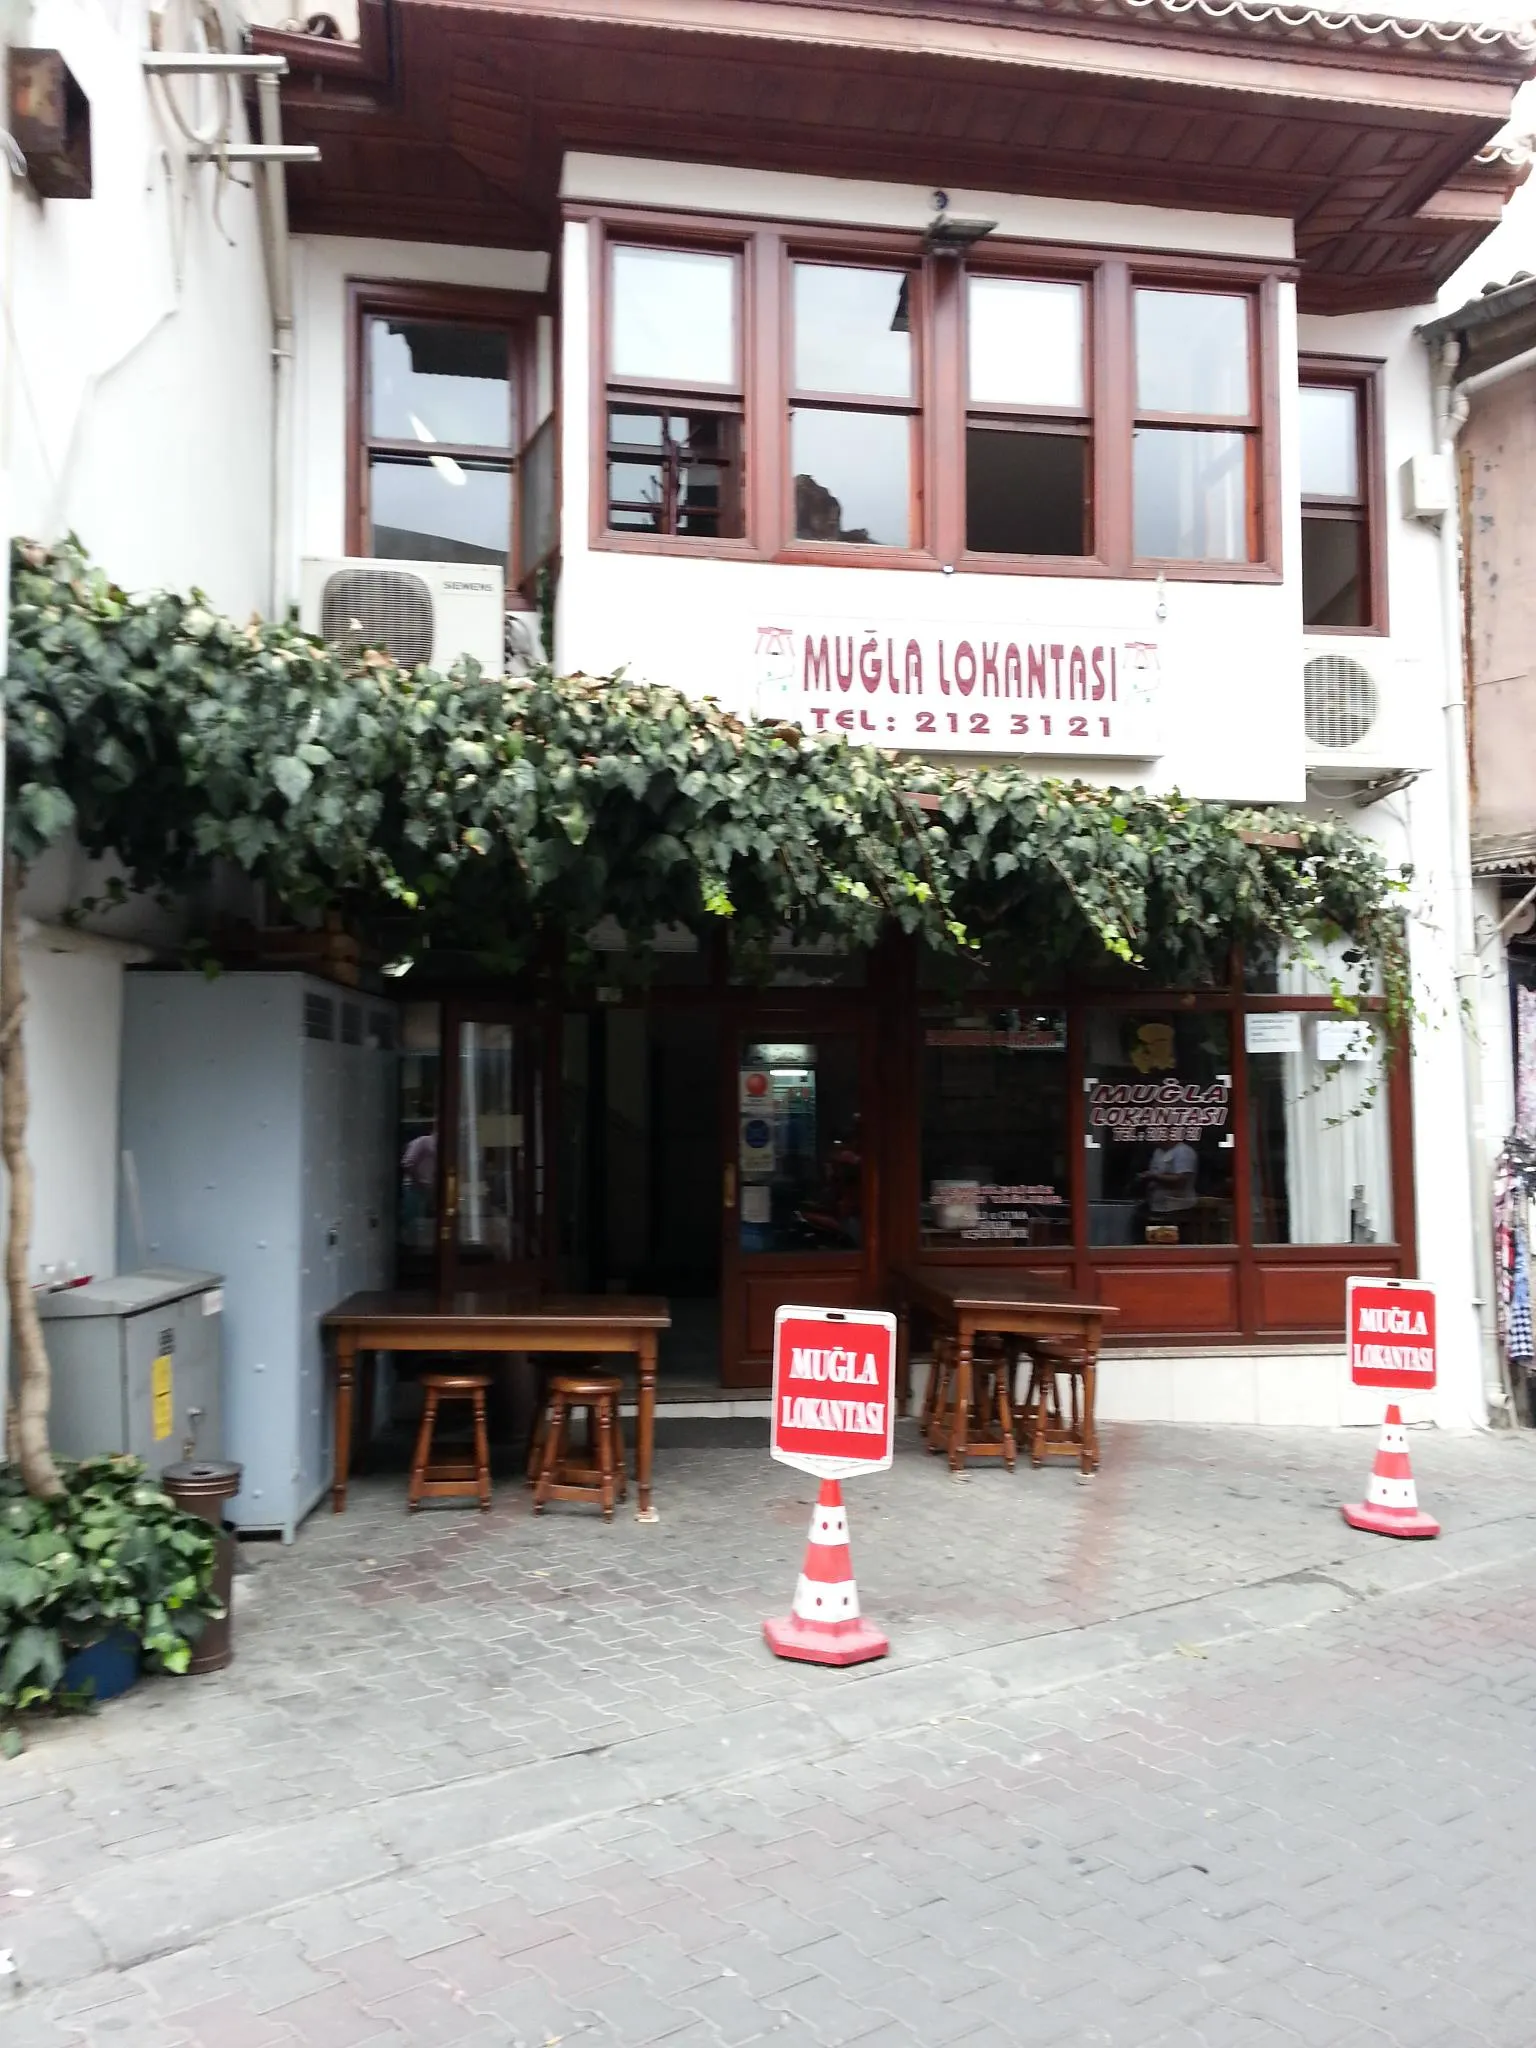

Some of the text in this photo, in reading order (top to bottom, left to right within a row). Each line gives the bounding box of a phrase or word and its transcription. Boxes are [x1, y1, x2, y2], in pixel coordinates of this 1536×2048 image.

[803, 628, 1118, 702] MUĞLA LOKANTASI
[915, 711, 991, 735] 212
[1089, 1077, 1229, 1104] MUĞLA
[1089, 1106, 1229, 1127] LOKANTASI
[1358, 1306, 1429, 1336] MUĞLA
[788, 1346, 880, 1386] MUĞLA
[1353, 1343, 1434, 1372] LOKANTASI
[781, 1395, 886, 1435] LOKANTASI
